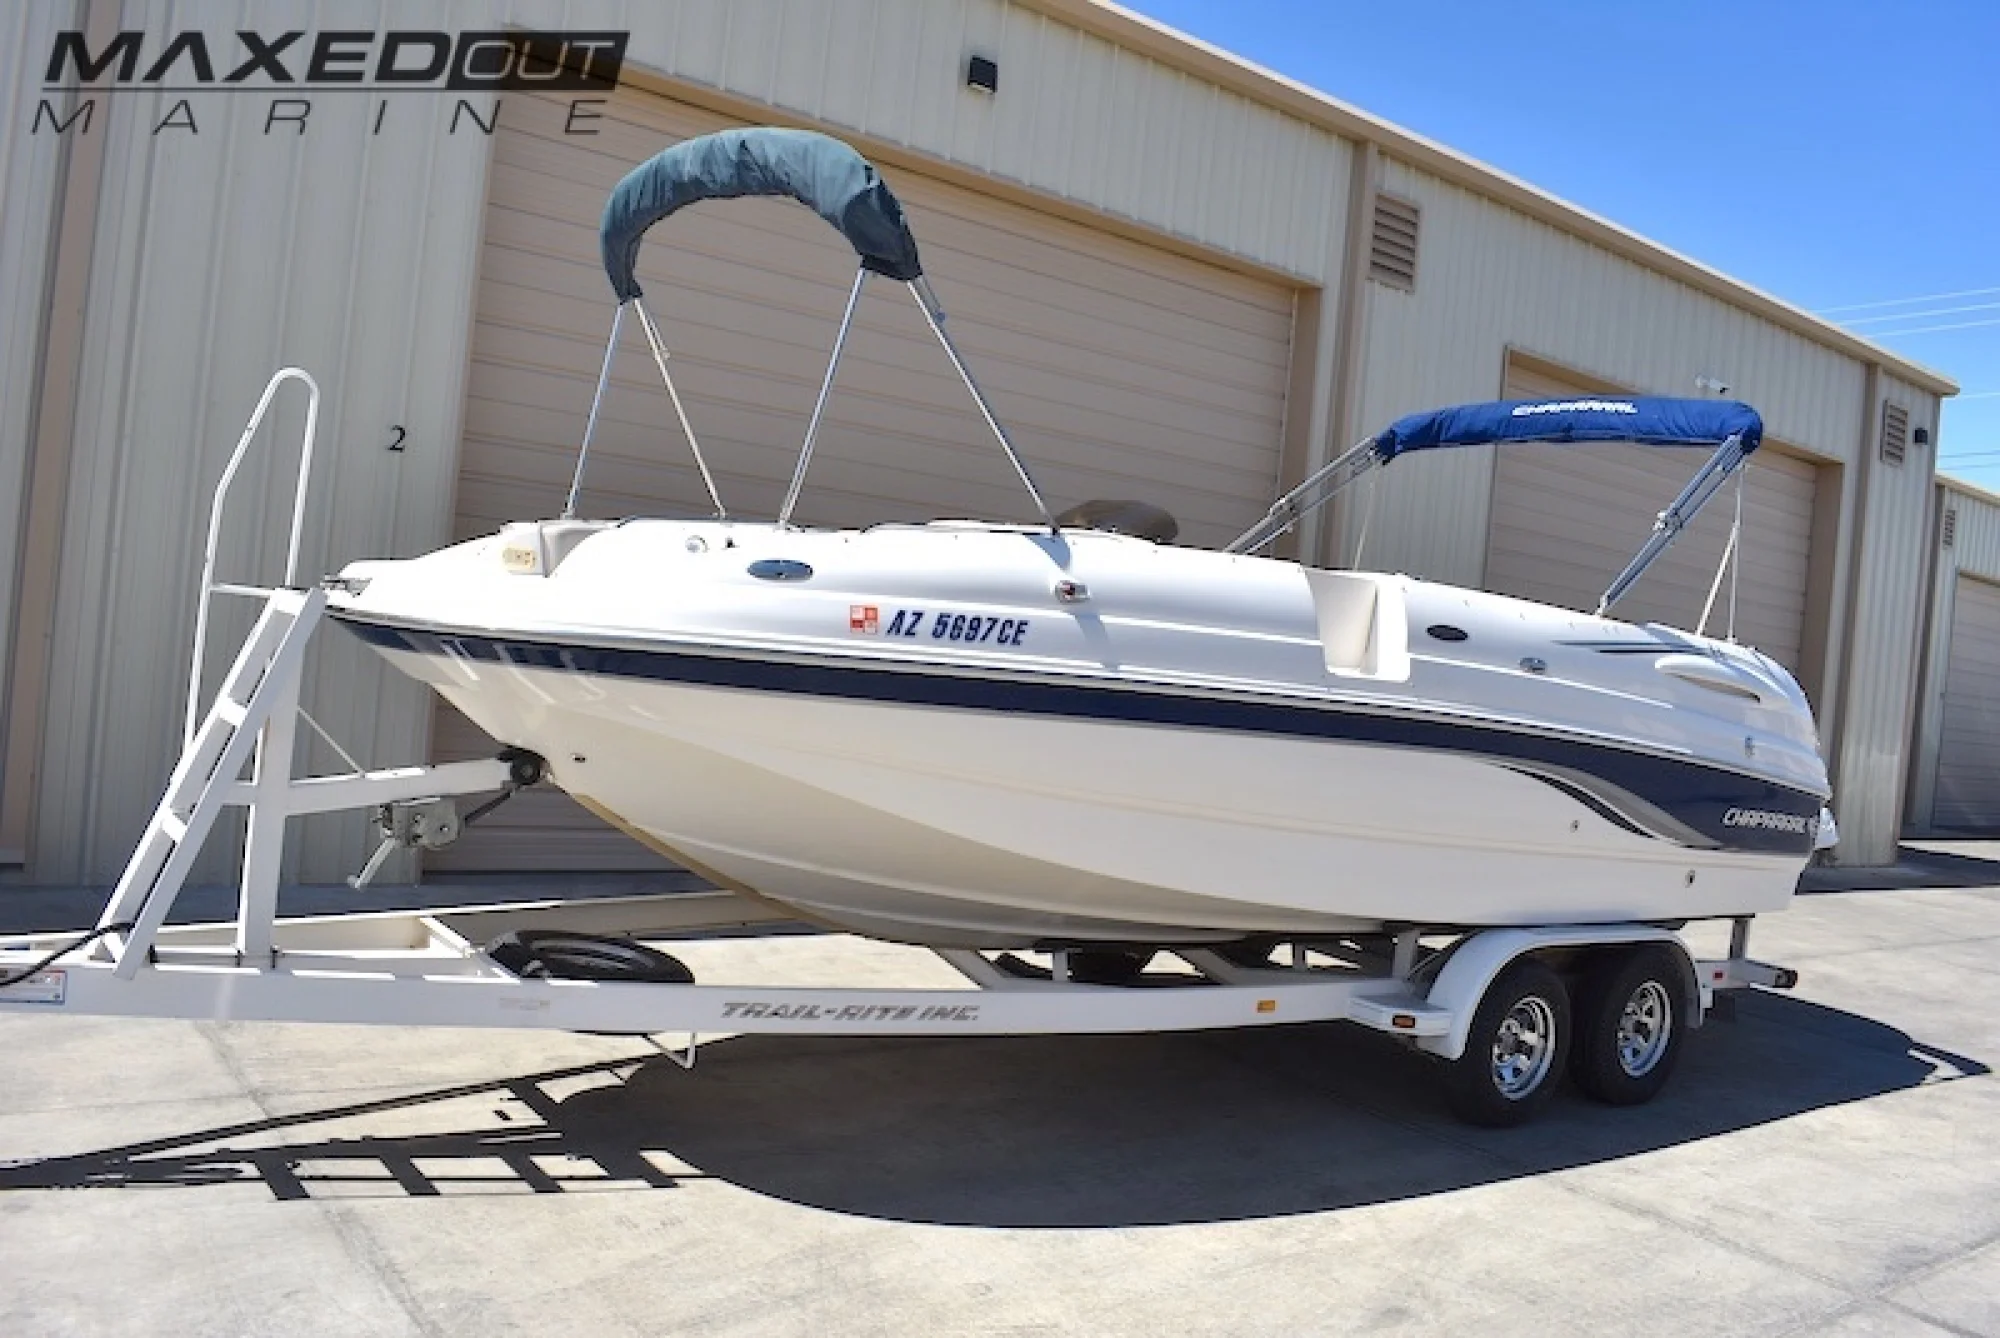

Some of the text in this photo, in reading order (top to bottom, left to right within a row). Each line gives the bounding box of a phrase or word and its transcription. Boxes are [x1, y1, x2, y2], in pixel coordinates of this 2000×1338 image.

[388, 424, 406, 453] 2
[886, 609, 925, 637] AZ
[1723, 806, 1806, 834] CHAPARRAL
[720, 1002, 981, 1021] TRAIL-RITE INC.
